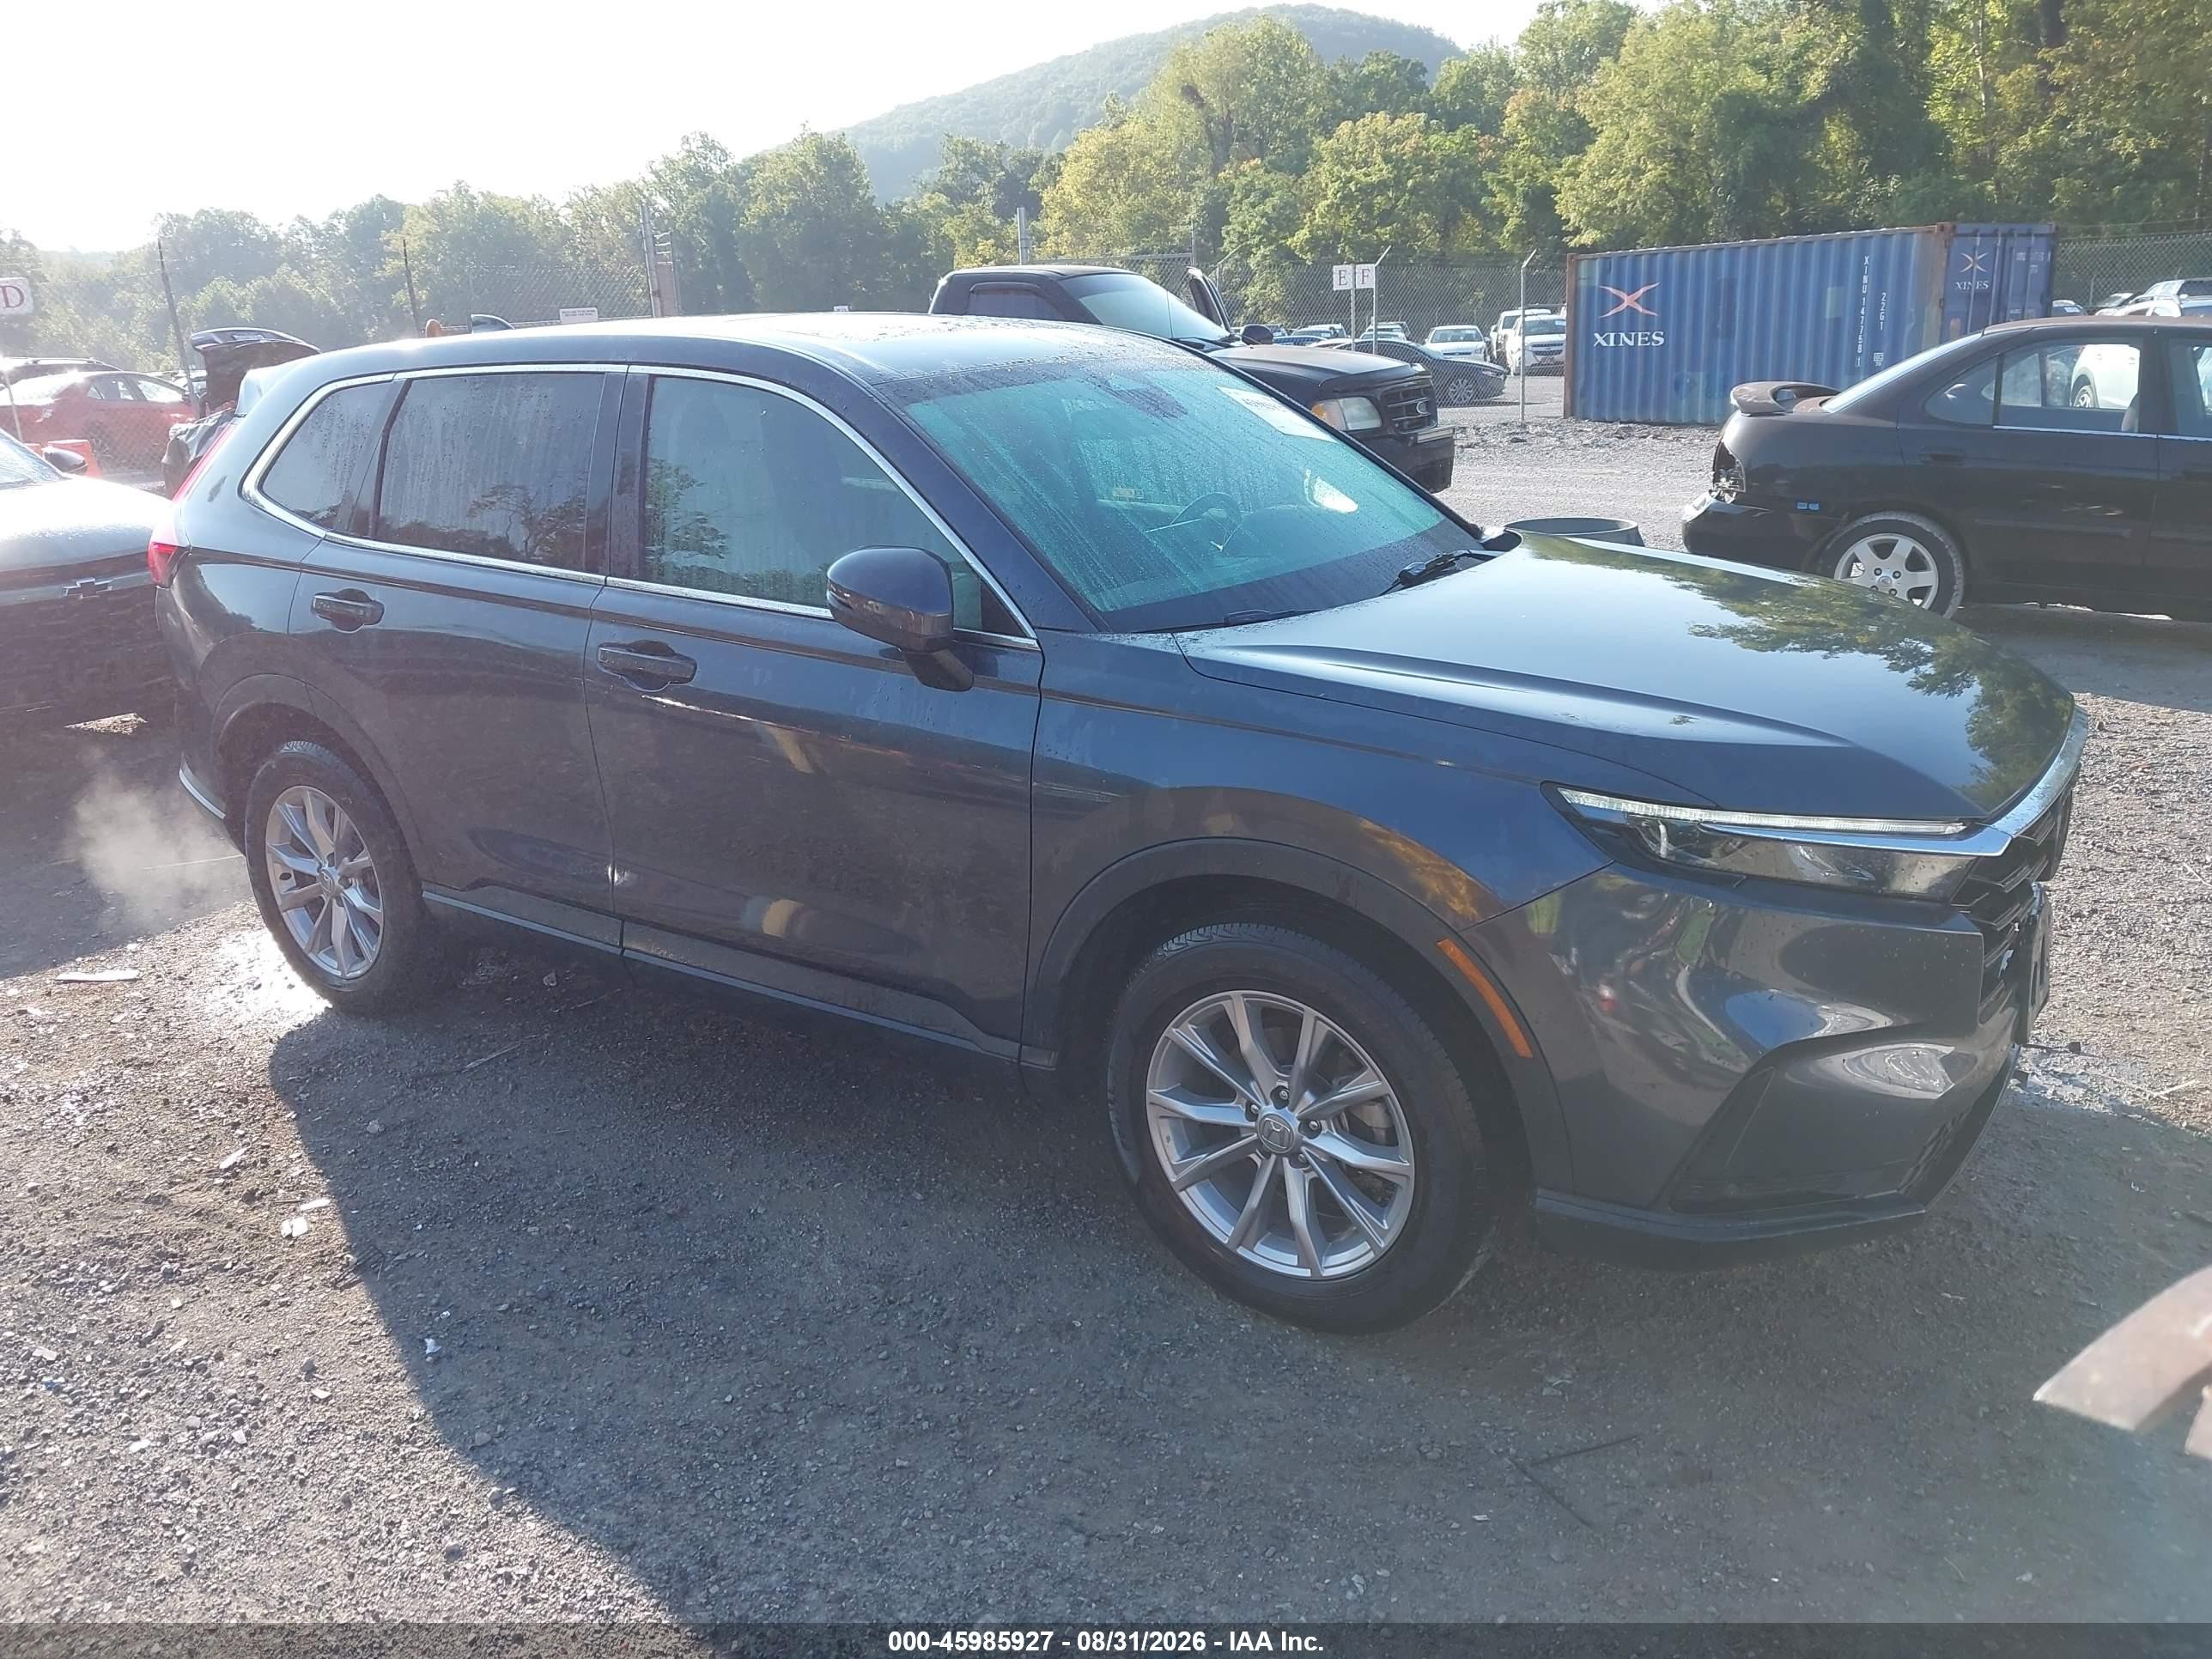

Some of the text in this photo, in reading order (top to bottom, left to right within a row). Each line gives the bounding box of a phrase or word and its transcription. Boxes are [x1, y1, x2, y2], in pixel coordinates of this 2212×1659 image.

[1338, 270, 1347, 286] E
[1361, 268, 1370, 285] F
[0, 285, 25, 308] D
[1856, 297, 1866, 354] 147758
[1593, 331, 1665, 347] XINES
